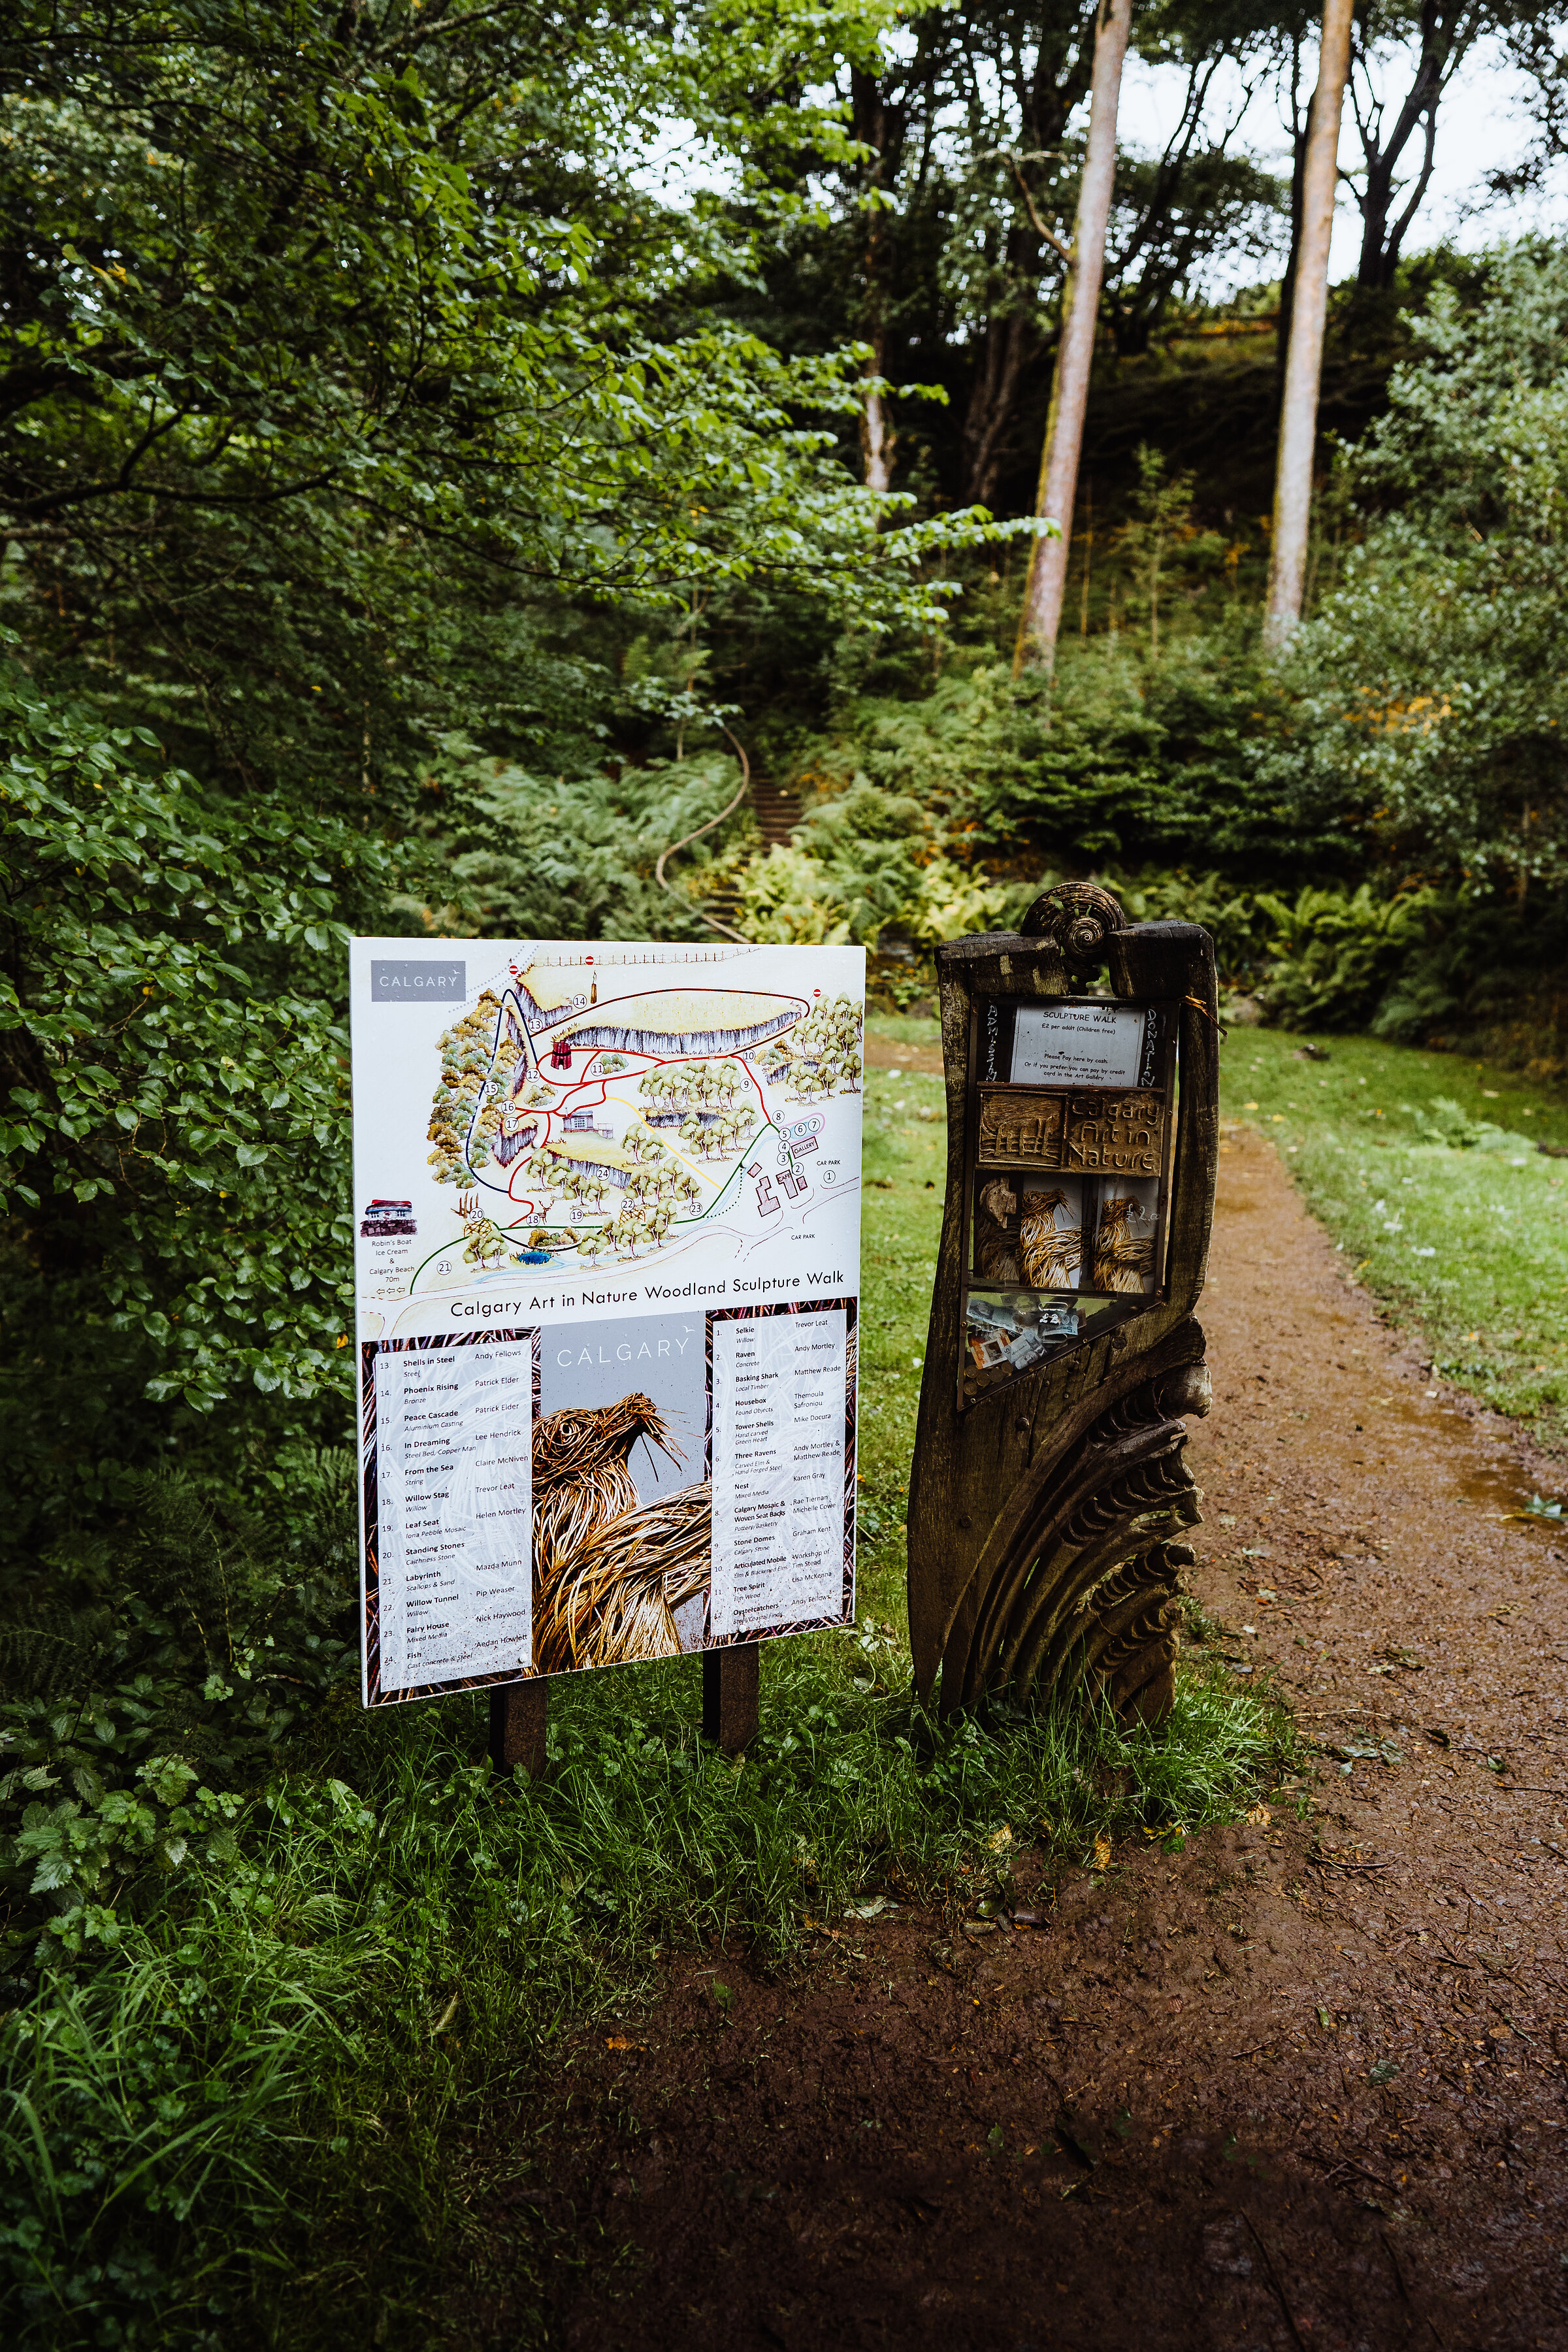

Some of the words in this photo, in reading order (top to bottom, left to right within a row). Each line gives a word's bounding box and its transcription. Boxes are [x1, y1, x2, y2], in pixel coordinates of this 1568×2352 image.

[379, 976, 457, 987] CALGARY
[1043, 1011, 1090, 1021] SCULPTURE
[1093, 1015, 1117, 1024] WALK
[1072, 1097, 1159, 1125] Calgary
[1081, 1120, 1118, 1142] Art
[1127, 1124, 1149, 1145] in
[794, 1141, 815, 1154] GALLERY
[1069, 1140, 1154, 1170] Nature
[777, 1173, 791, 1182] CAFE
[451, 1301, 521, 1318] Calgary
[529, 1296, 554, 1310] Art
[562, 1294, 575, 1307] in
[582, 1292, 638, 1305] Nature
[644, 1280, 726, 1299] Woodland
[732, 1277, 800, 1293] Sculpture
[806, 1270, 844, 1285] Walk
[557, 1337, 689, 1367] CALGARY
[811, 1343, 836, 1351] Mortley
[403, 1358, 425, 1367] Shells
[436, 1356, 455, 1364] Steel
[794, 1367, 822, 1376] Matthew
[475, 1378, 499, 1387] Patrick
[736, 1374, 760, 1383] Basking
[404, 1385, 434, 1394] Phoenix
[436, 1382, 459, 1391] Rising
[794, 1391, 824, 1399] Themoula
[735, 1397, 766, 1407] Housebox
[794, 1401, 823, 1409] Safroniou
[475, 1405, 499, 1414] Patrick
[501, 1403, 519, 1412] Elder
[404, 1414, 427, 1422] Peace
[428, 1410, 459, 1419] Cascade
[489, 1429, 521, 1439] Hendrick
[414, 1438, 451, 1448] Dreaming
[475, 1458, 496, 1467] Claire
[497, 1455, 529, 1464] McNiven
[404, 1467, 425, 1476] From
[475, 1485, 498, 1494] Trevor
[405, 1493, 431, 1503] Willow
[433, 1491, 449, 1500] Stag
[476, 1511, 497, 1520] Helen
[498, 1508, 527, 1516] Mortley
[405, 1520, 421, 1529] Leaf
[423, 1518, 440, 1527] Seat
[406, 1544, 438, 1556] Standing
[440, 1542, 465, 1551] Stones
[476, 1563, 500, 1571] Mazda
[406, 1571, 441, 1582] Labyrinth
[489, 1586, 515, 1595] Weaser
[406, 1599, 433, 1608] Willow
[434, 1593, 459, 1603] Tunnel
